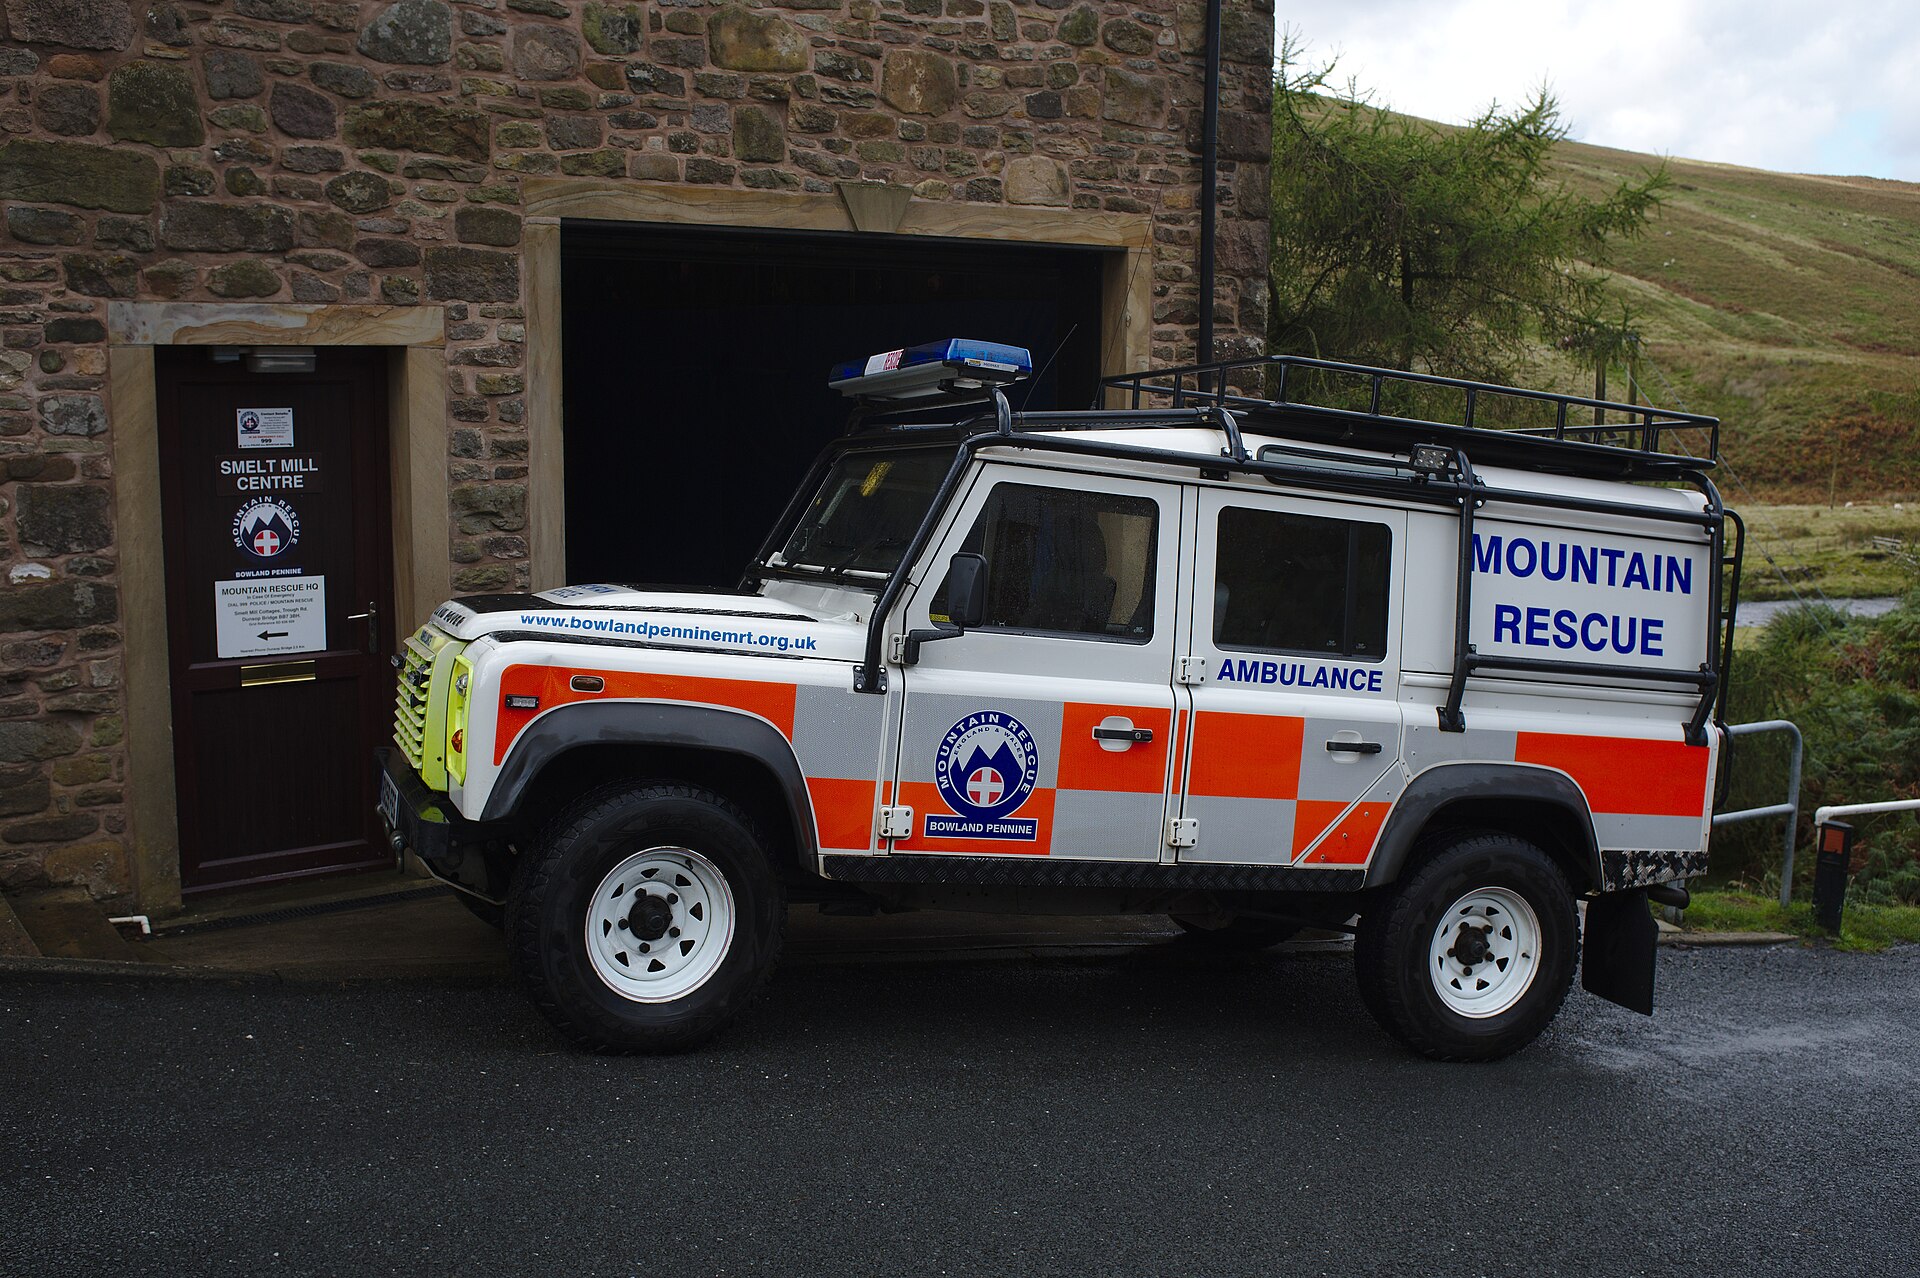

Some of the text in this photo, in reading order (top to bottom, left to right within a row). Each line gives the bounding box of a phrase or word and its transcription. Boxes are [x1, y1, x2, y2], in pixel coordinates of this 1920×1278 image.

[220, 458, 318, 474] SMELT MILL
[237, 475, 304, 490] CENTRE
[232, 496, 300, 548] MOUNTAIN RESCUE
[235, 570, 270, 578] BOWLAND
[1471, 532, 1693, 595] MOUNTAIN
[222, 586, 267, 595] MOUNTAIN
[270, 584, 304, 592] RESCUE
[520, 614, 817, 651] www.bowlandpenninemrt.org.uk
[1493, 604, 1664, 657] RESCUE
[1217, 658, 1383, 692] AMBULANCE
[938, 714, 1036, 794] MOUNTAIN RESCUE
[954, 727, 990, 755] ENGLAND
[1004, 731, 1023, 759] WALES
[930, 821, 1033, 834] BOWLAND PENNINE
